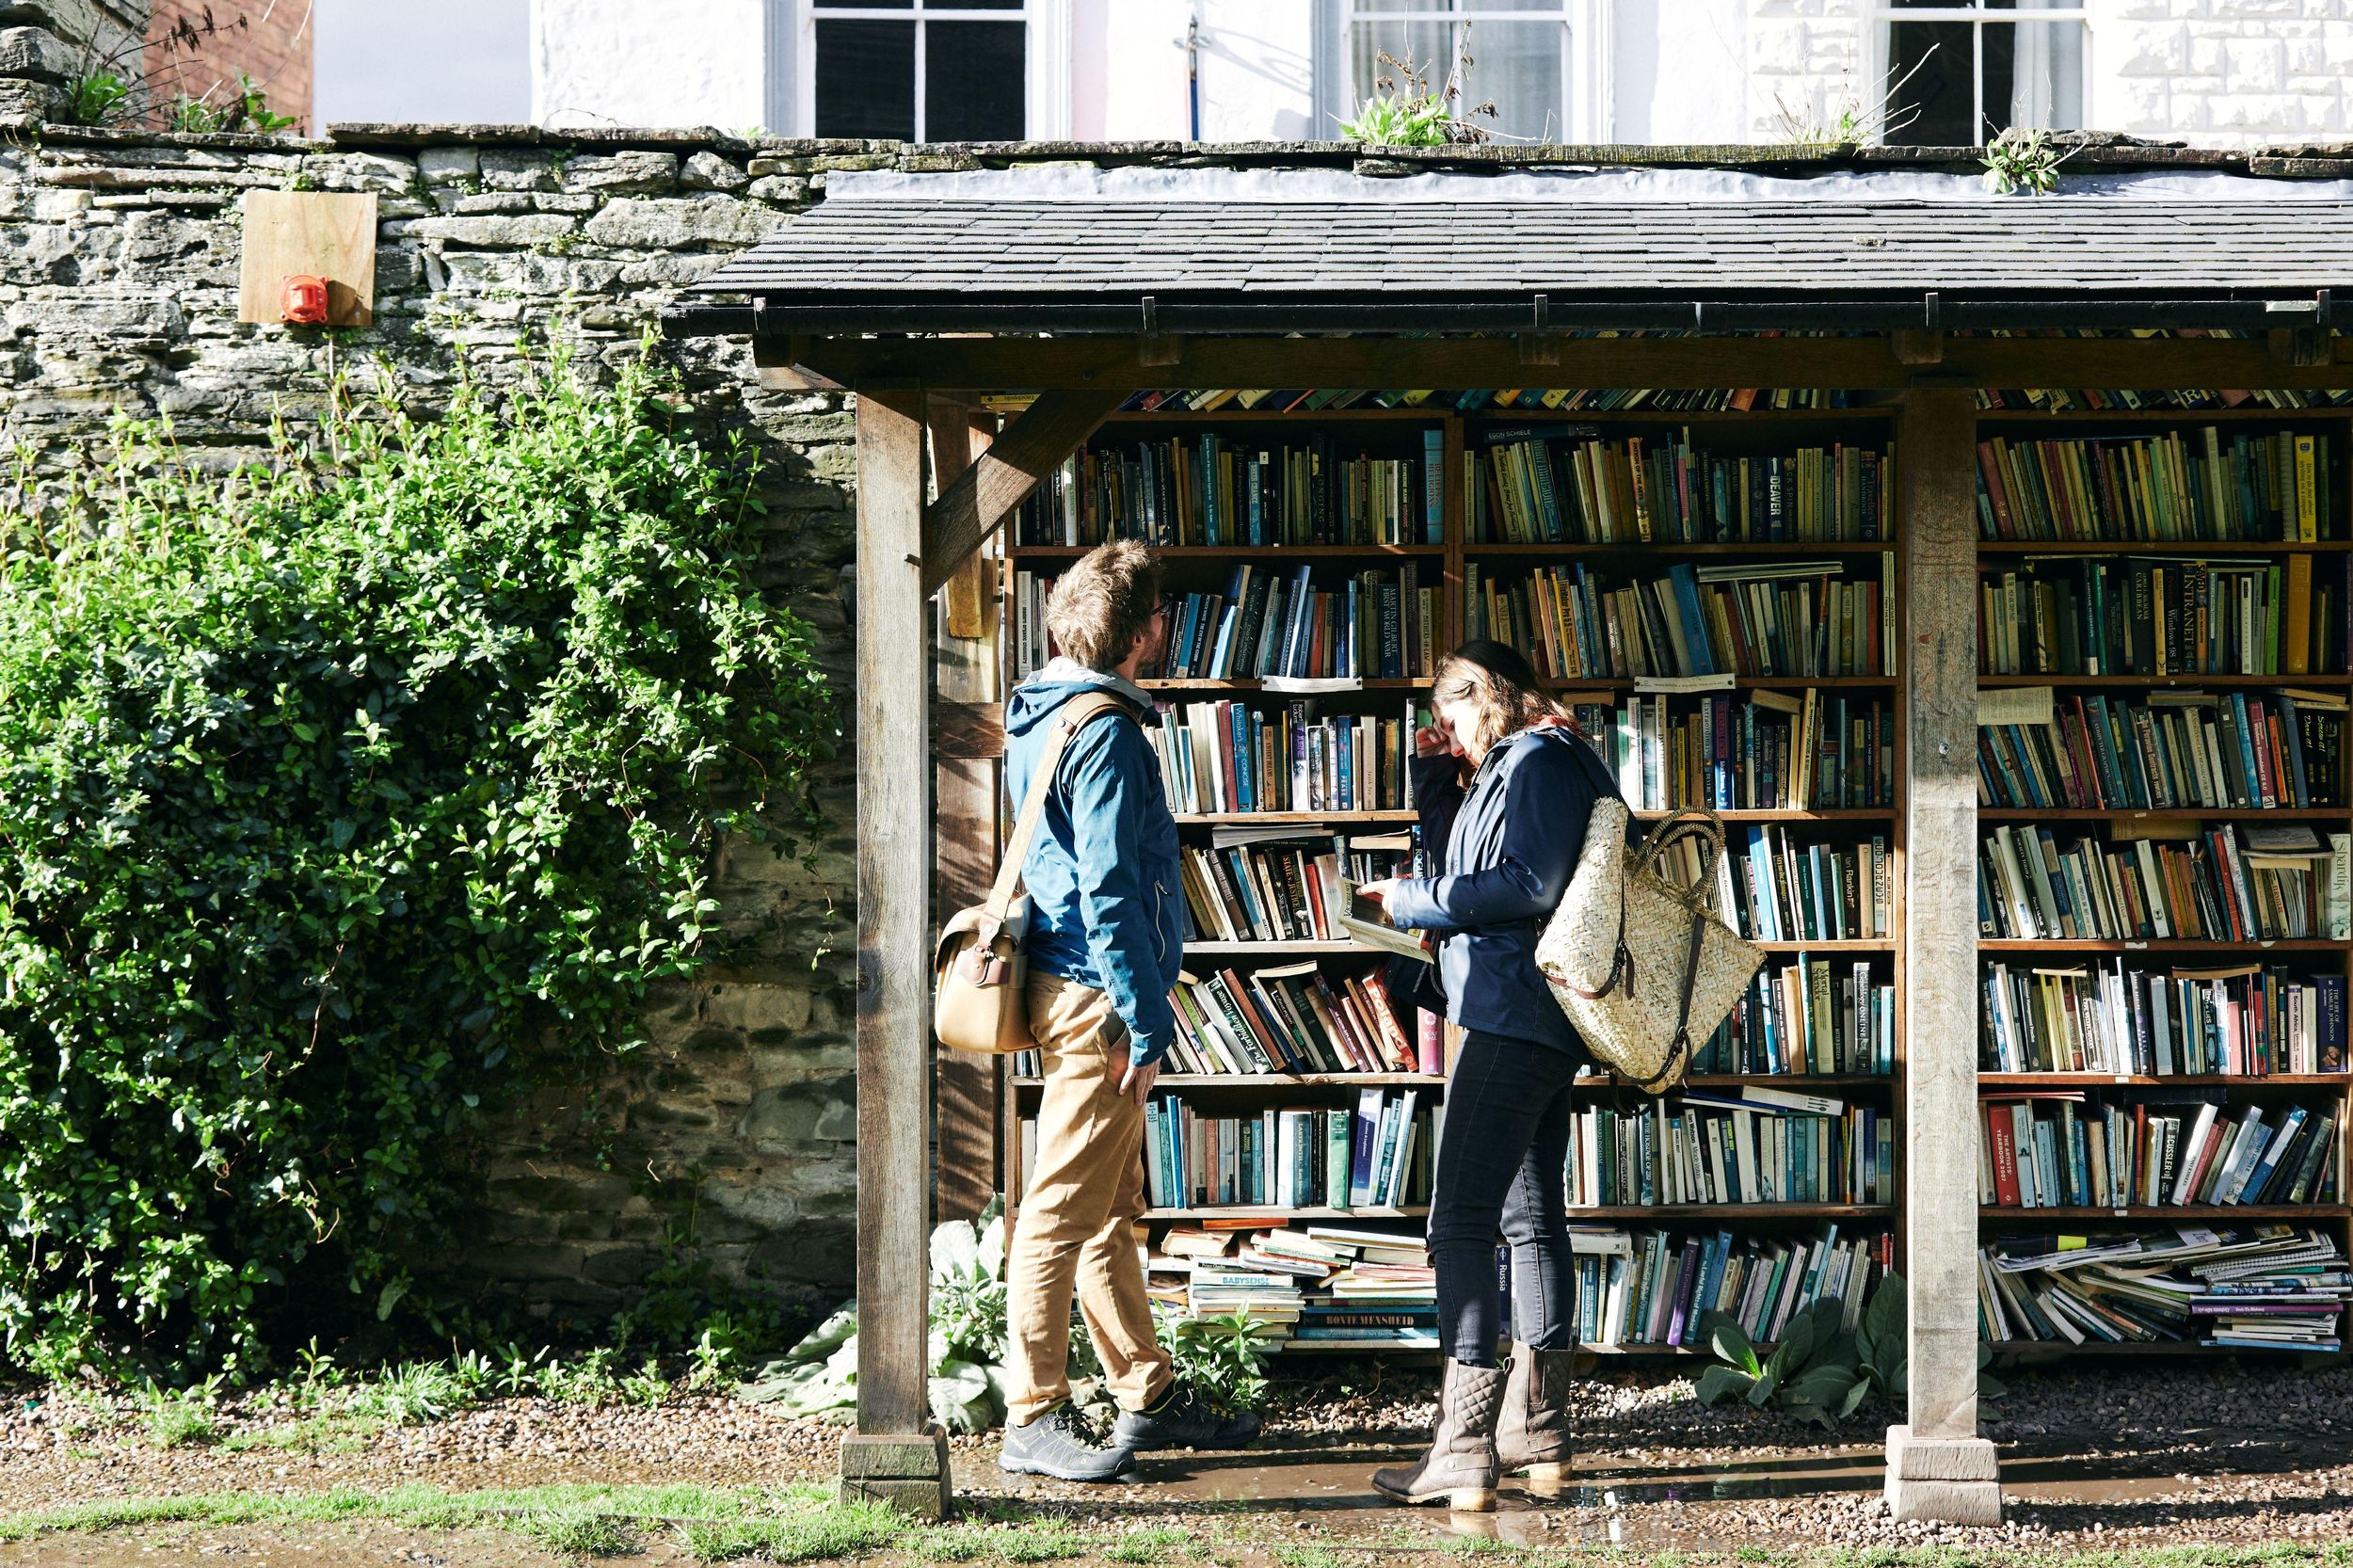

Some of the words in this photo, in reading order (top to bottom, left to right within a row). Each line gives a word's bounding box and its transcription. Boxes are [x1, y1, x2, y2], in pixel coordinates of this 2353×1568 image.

[1770, 475, 1782, 516] DEAVER
[2197, 566, 2207, 591] SAVED
[2184, 574, 2197, 645] INTRANET
[2168, 609, 2176, 646] Windows
[2169, 647, 2176, 658] 98
[1704, 703, 1712, 754] Extraordinary
[1241, 759, 1250, 787] CONCISE
[2021, 859, 2029, 874] TODAY
[2334, 841, 2350, 890] Shardik
[1813, 968, 1823, 1001] Splendor
[1820, 968, 1830, 996] Mortal
[1217, 989, 1239, 1016] Voyage
[1369, 986, 1409, 1049] Poland
[1232, 1016, 1259, 1051] Forbidden
[1996, 1128, 2006, 1165] YEARBOOK
[2163, 1139, 2176, 1171] CUSSLER
[1223, 1276, 1271, 1285] BABYSENSE
[1498, 1264, 1508, 1291] Russia
